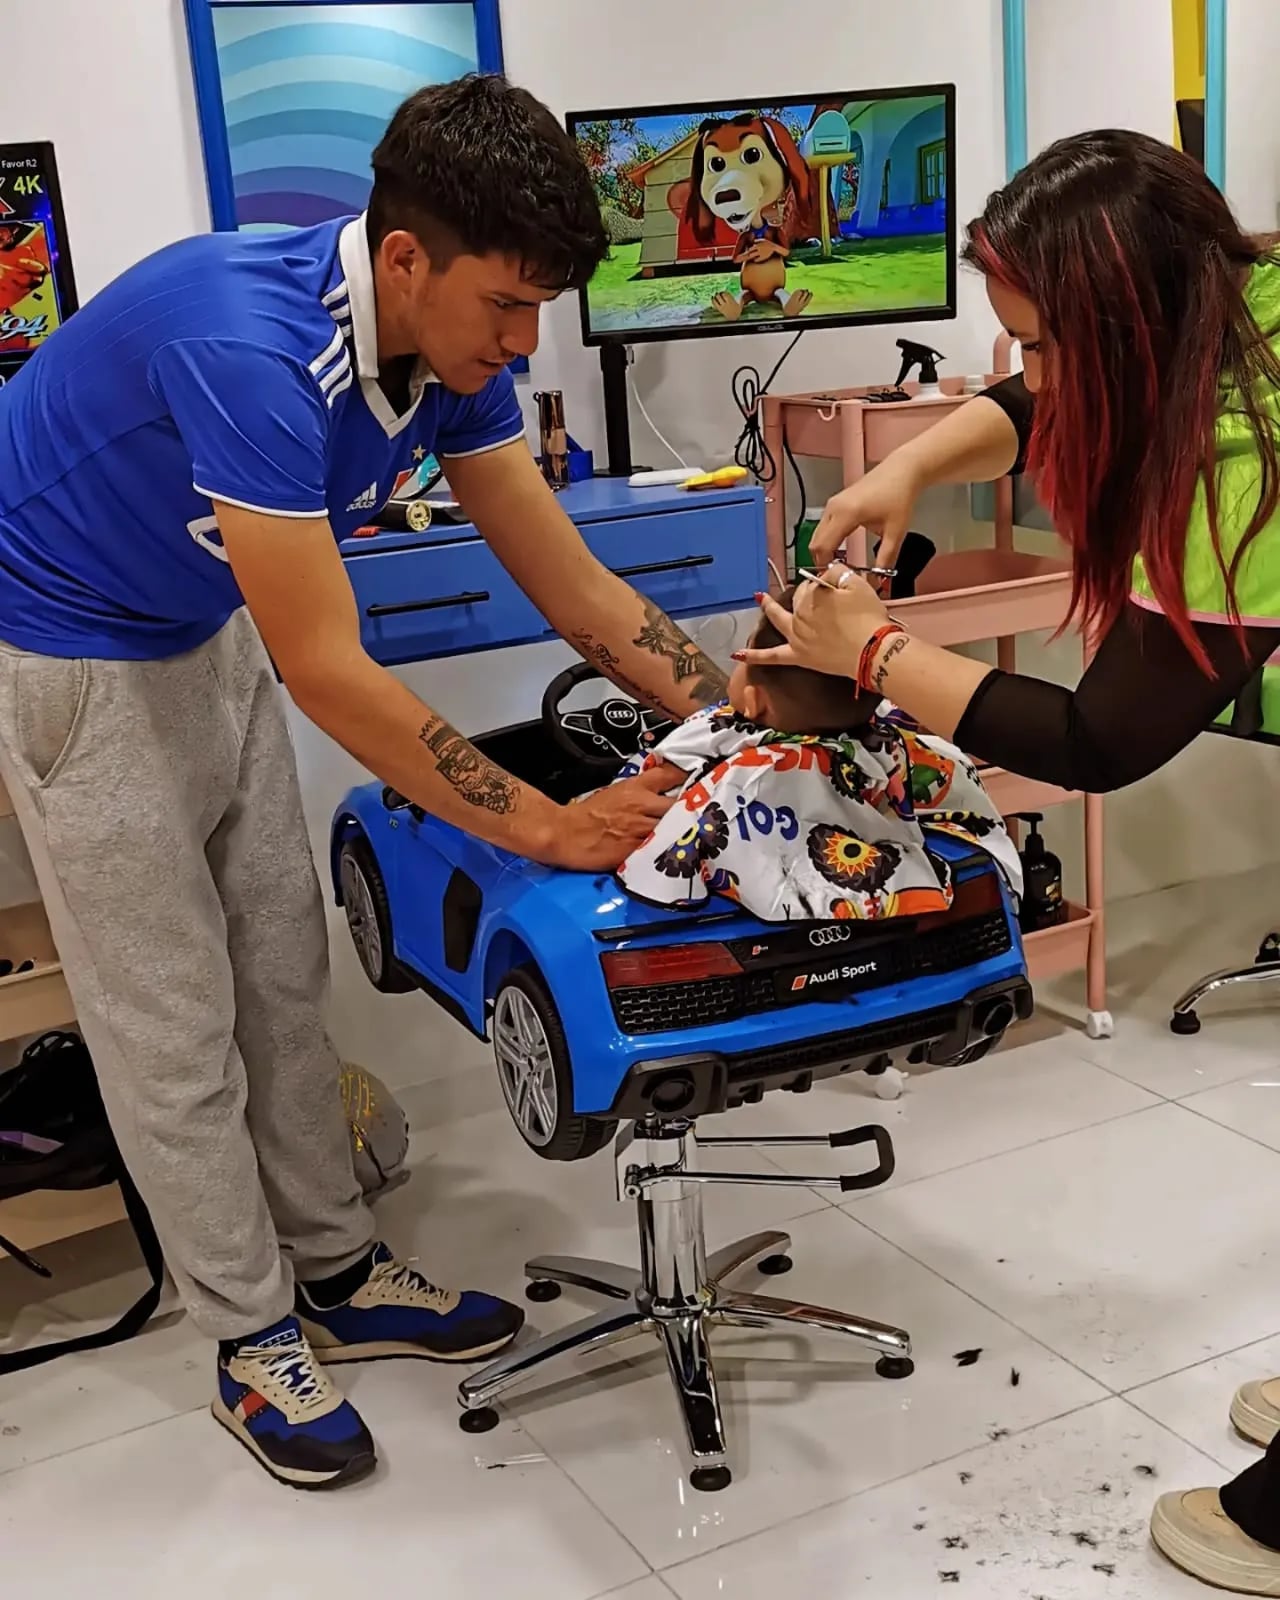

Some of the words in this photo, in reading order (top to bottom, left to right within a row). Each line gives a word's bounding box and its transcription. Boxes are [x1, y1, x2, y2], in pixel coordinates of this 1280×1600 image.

[1, 160, 24, 168] Favor
[25, 159, 37, 168] R2
[13, 174, 43, 195] 4K
[736, 795, 799, 841] GO!
[809, 969, 839, 984] Audi
[841, 961, 877, 979] Sport
